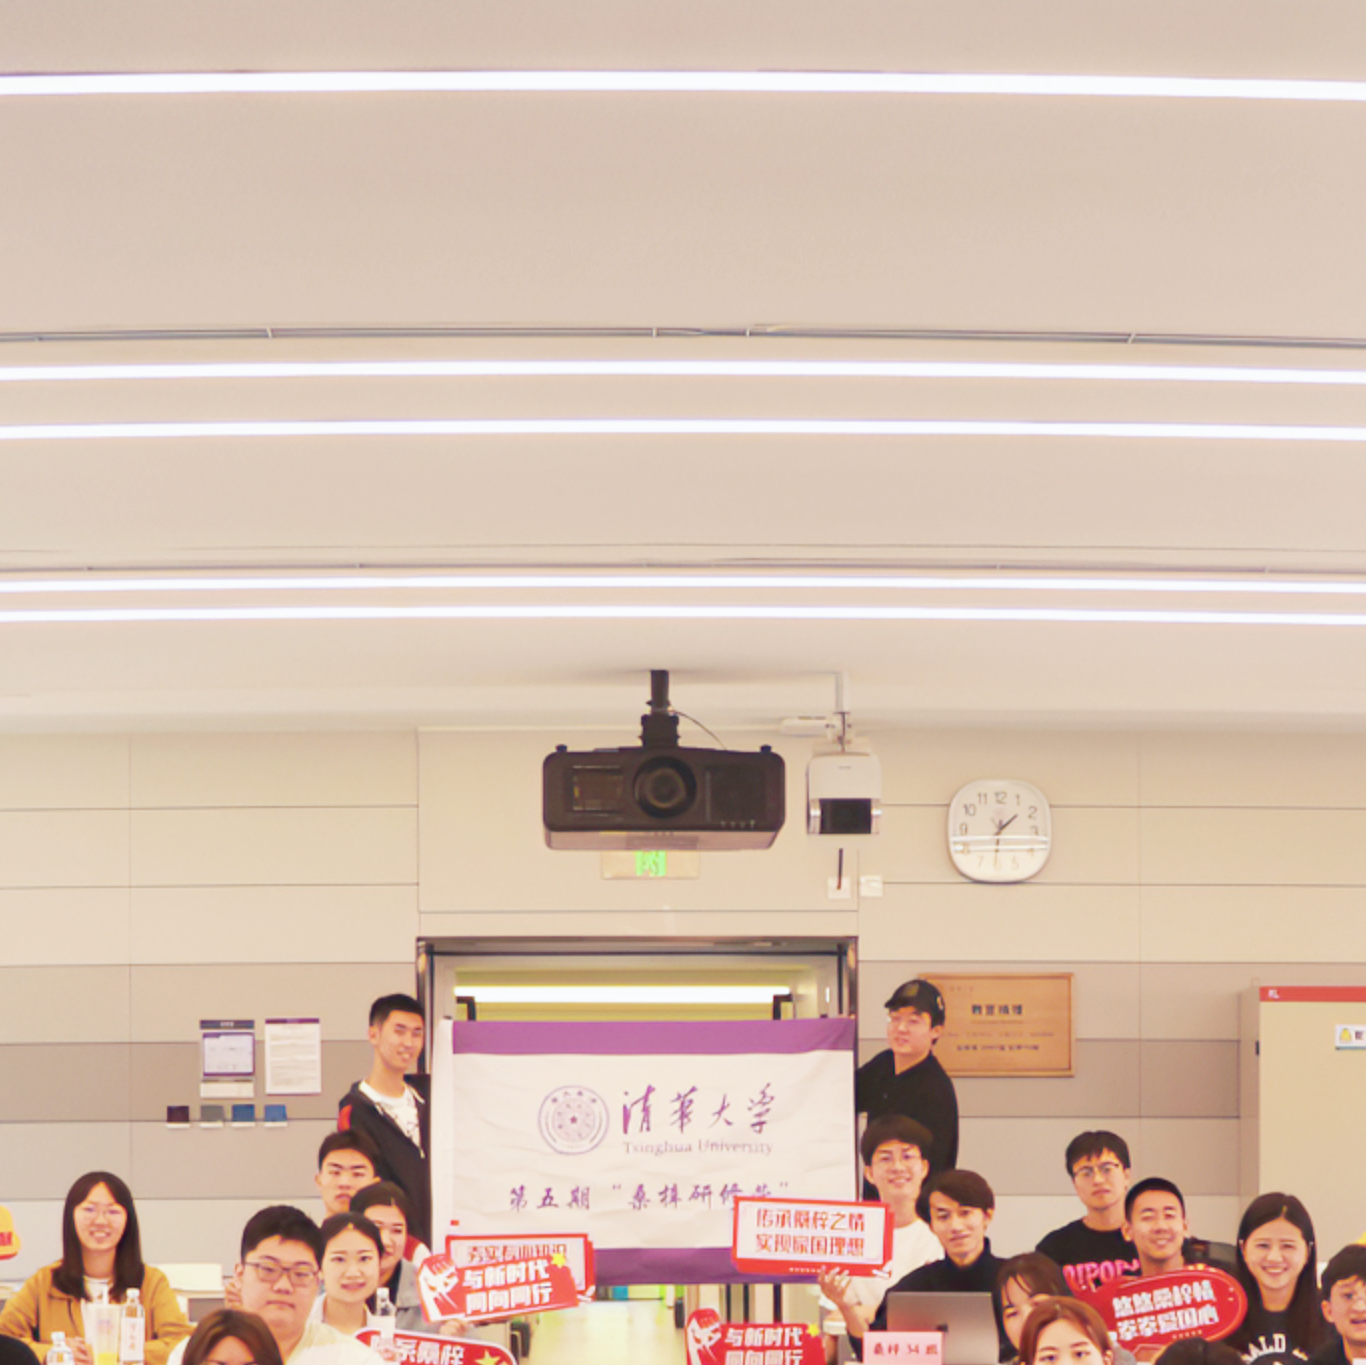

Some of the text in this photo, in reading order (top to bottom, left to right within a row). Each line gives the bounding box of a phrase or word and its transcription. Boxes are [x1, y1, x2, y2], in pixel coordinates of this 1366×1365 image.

[995, 791, 1008, 805] 12
[963, 803, 977, 817] 10
[1028, 805, 1038, 820] 2
[623, 1139, 773, 1157] Tsinghua University
[510, 1184, 591, 1212] 第五期
[756, 1208, 865, 1233] 传承桑梓之情
[756, 1233, 864, 1257] 实现家国理想
[463, 1259, 549, 1289] 与新时代
[466, 1282, 552, 1315] 同向同行
[724, 1327, 803, 1347] 与新时代
